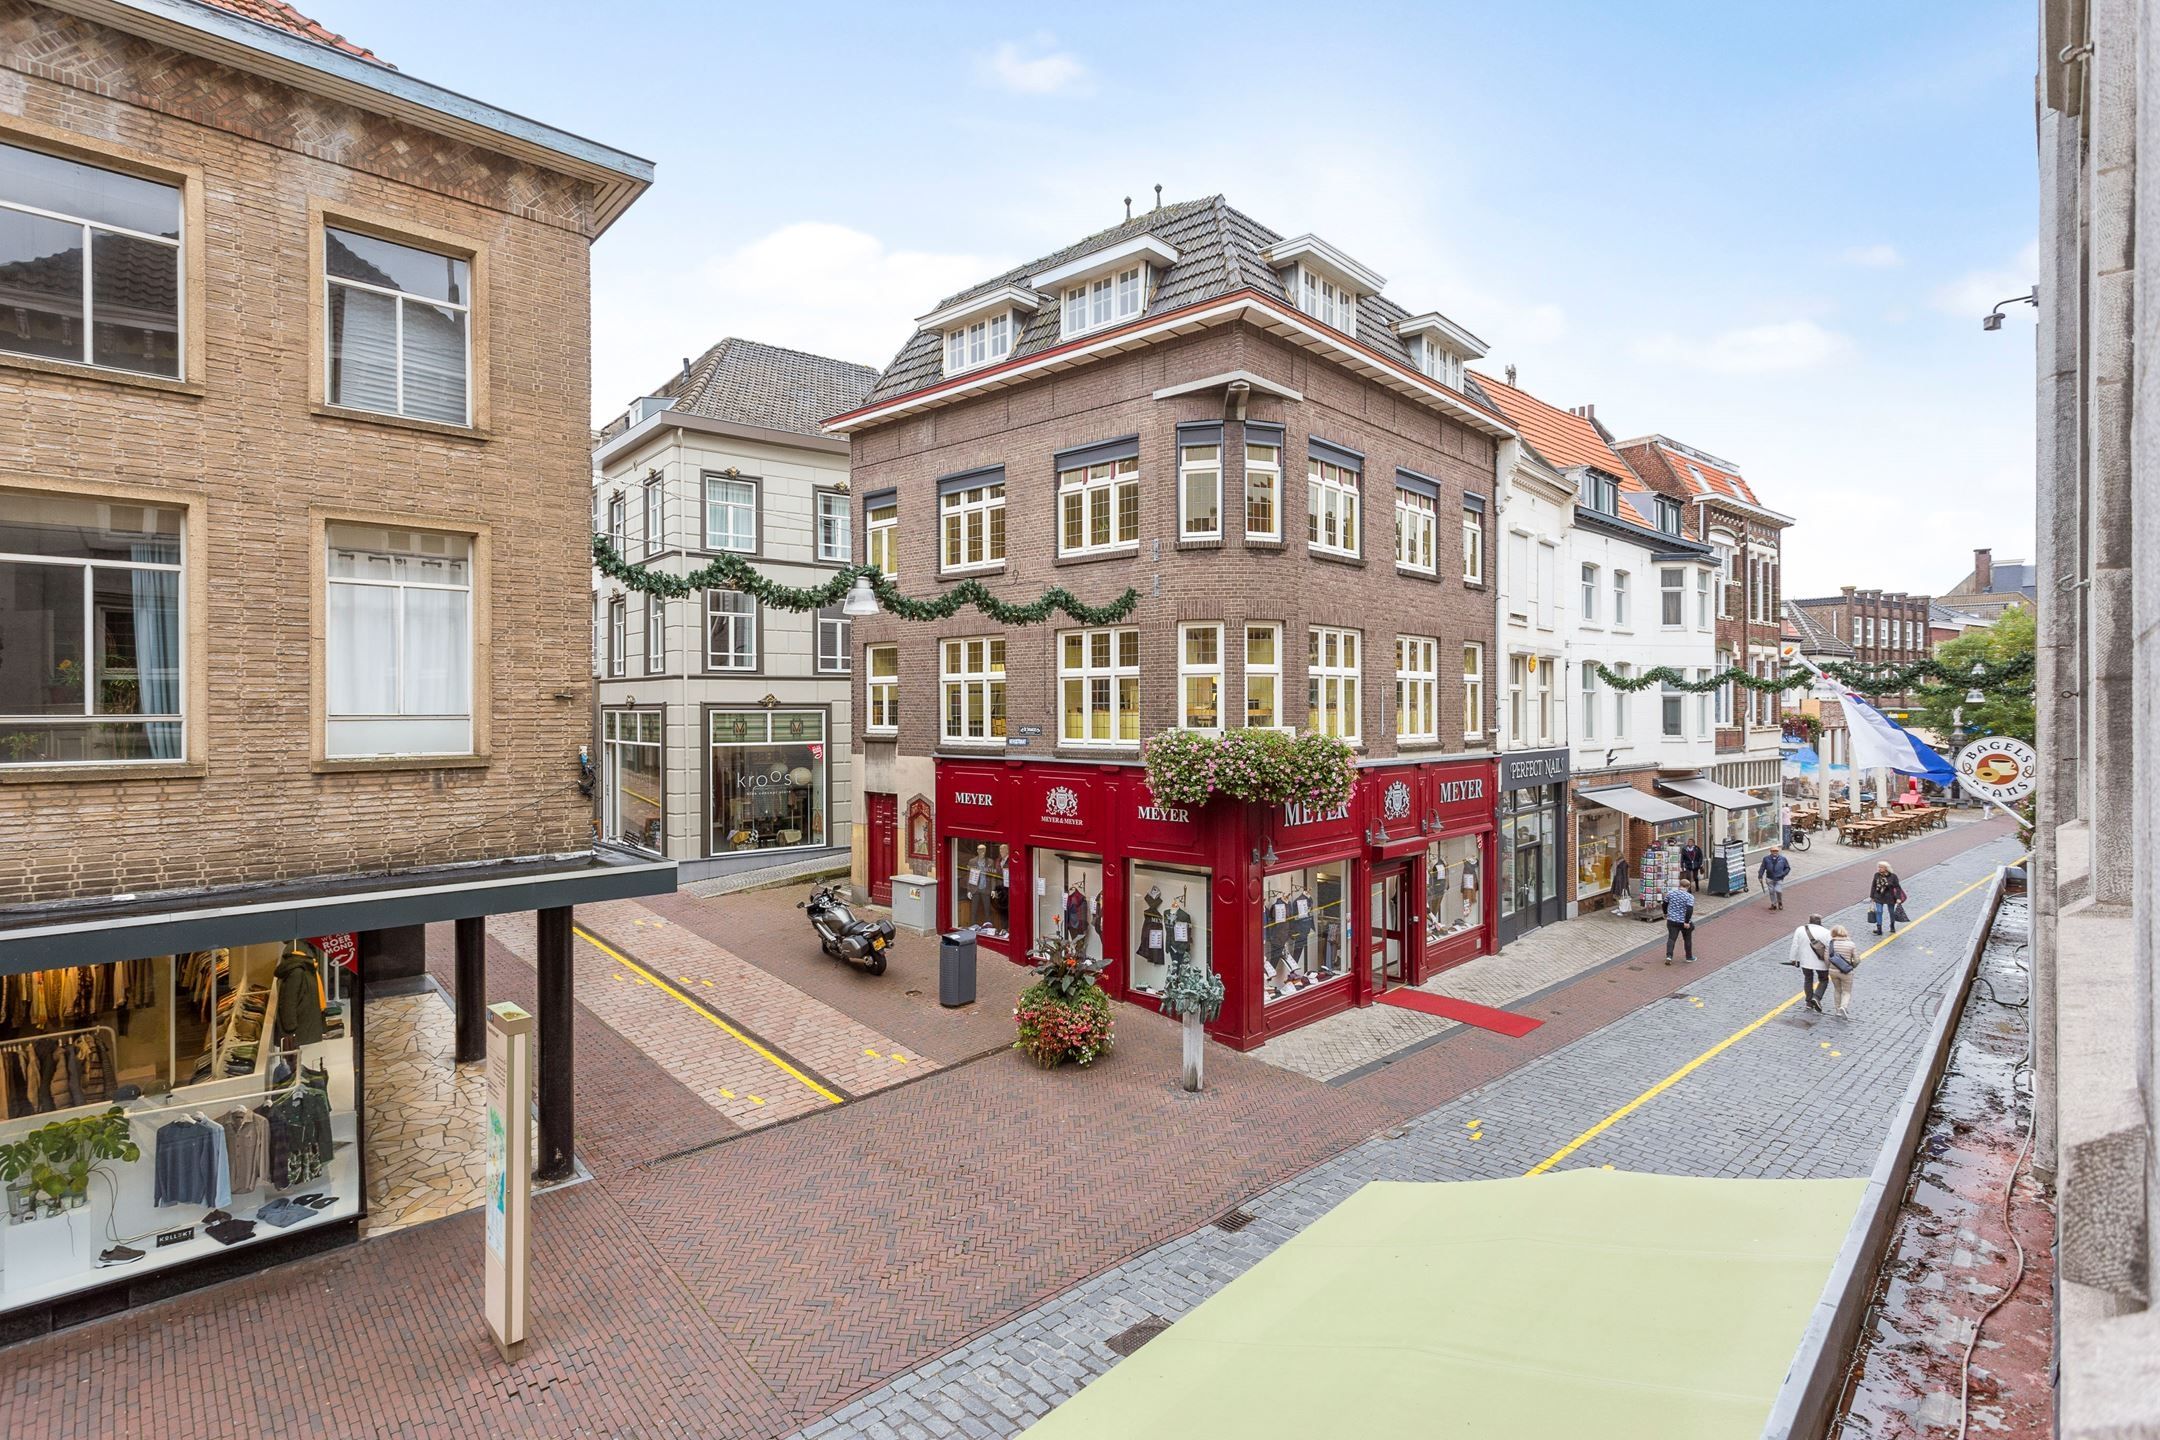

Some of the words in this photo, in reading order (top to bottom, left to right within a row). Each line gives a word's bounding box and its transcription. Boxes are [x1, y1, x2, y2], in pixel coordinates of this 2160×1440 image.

[1965, 741, 2032, 763] BAGELS
[1510, 760, 1543, 779] PERFECT
[1545, 758, 1564, 778] NAILS
[954, 792, 993, 806] MEYER
[1440, 779, 1483, 804] MEYER
[1137, 805, 1190, 823] MEYER
[322, 935, 351, 949] ROER
[325, 941, 353, 954] MOND
